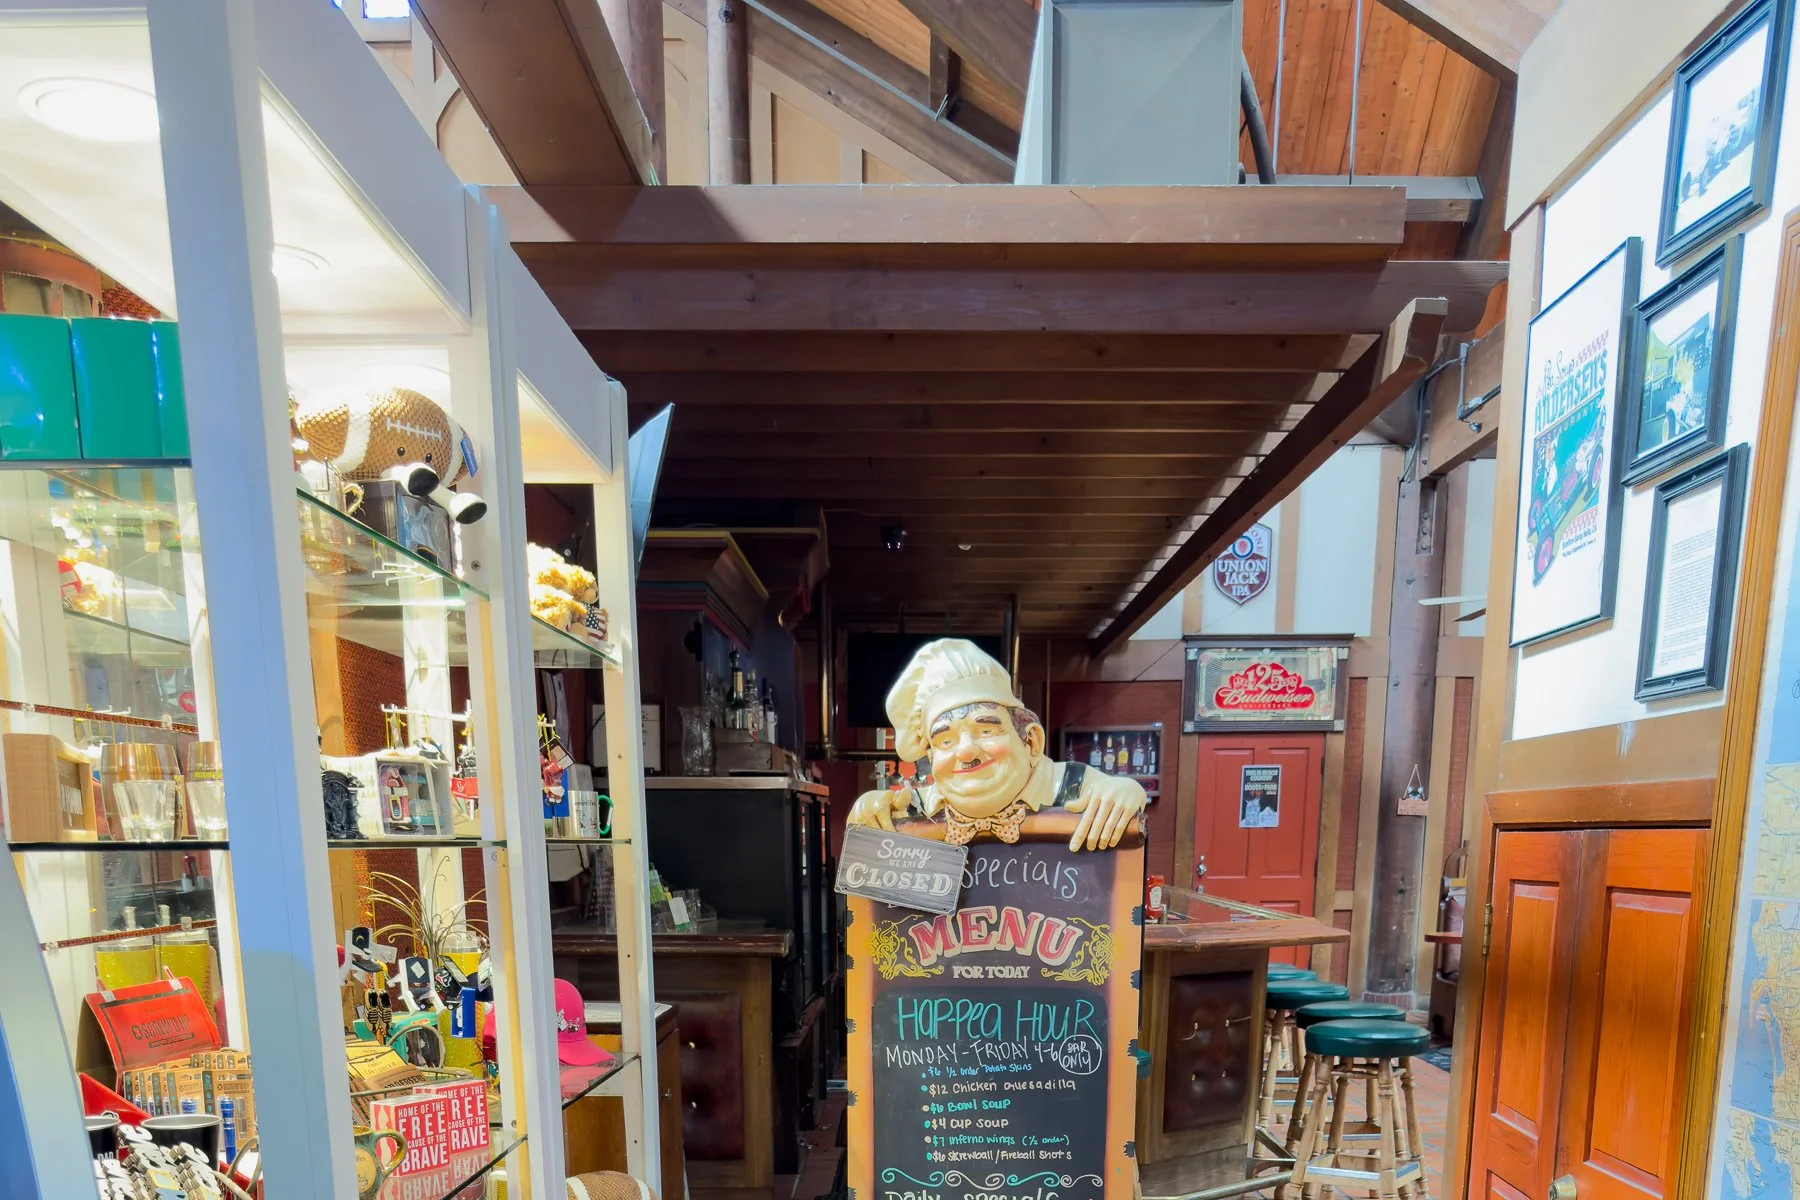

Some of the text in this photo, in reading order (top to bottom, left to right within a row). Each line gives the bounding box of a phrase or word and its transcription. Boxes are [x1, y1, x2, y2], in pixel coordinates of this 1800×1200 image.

[1535, 347, 1608, 433] ANDERSEN'S
[1217, 559, 1267, 573] UNION
[1223, 572, 1260, 587] JACK
[1231, 585, 1251, 596] IPA
[1219, 689, 1312, 706] Budweiser
[877, 839, 931, 869] Sorry
[889, 859, 901, 867] WE
[845, 862, 953, 897] CLOSED
[908, 905, 1083, 966] MENU
[953, 965, 1031, 979] FOR TODAY
[1066, 1043, 1089, 1055] BAR
[1062, 1052, 1092, 1072] ONLY
[384, 1074, 427, 1089] NDERSEN
[929, 1083, 949, 1097] $12
[952, 1081, 997, 1094] Chicken
[460, 1087, 469, 1098] OF
[471, 1085, 484, 1096] THE
[398, 1101, 445, 1117] HOME OF THE
[451, 1097, 486, 1120] REE
[930, 1102, 944, 1115] $6
[947, 1098, 978, 1112] Bowl
[399, 1111, 447, 1139] FREE
[448, 1116, 486, 1130] CAUSE OF THE
[931, 1117, 946, 1130] $4
[407, 1134, 447, 1148] CAUSE OF THE
[451, 1125, 488, 1151] RAVE
[932, 1135, 945, 1147] $7
[986, 1135, 1016, 1146] wings
[401, 1142, 449, 1173] BRAVE
[932, 1150, 946, 1162] $6
